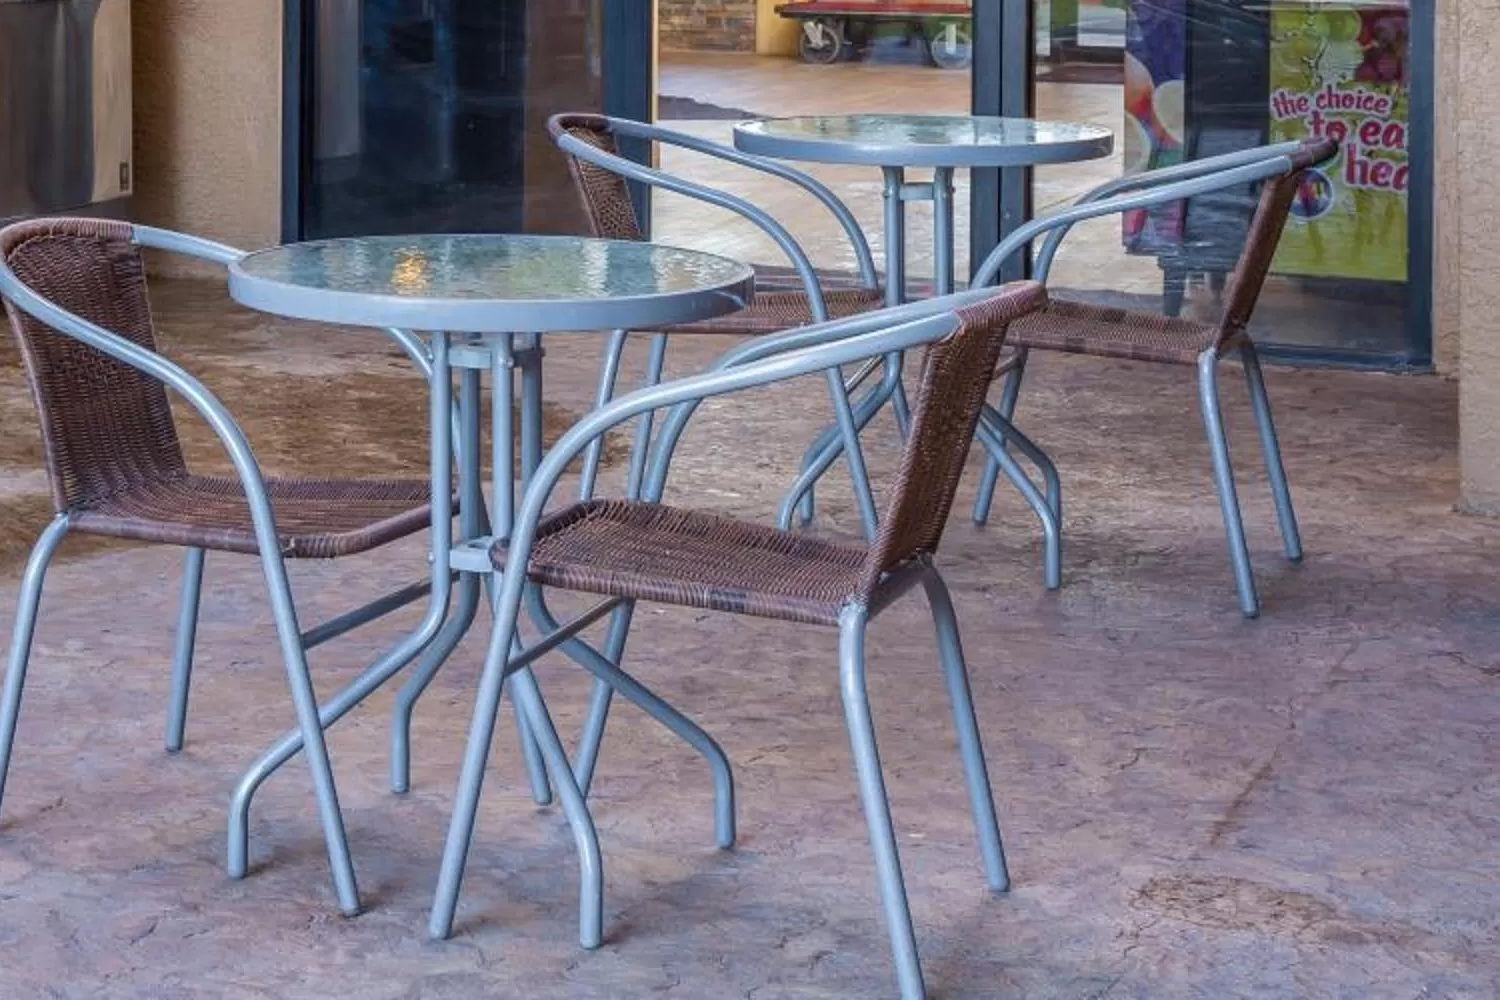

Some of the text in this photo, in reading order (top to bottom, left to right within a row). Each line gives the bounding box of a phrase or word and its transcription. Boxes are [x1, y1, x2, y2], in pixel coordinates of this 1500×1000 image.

[1271, 84, 1390, 119] the choice
[1308, 110, 1408, 149] to ea
